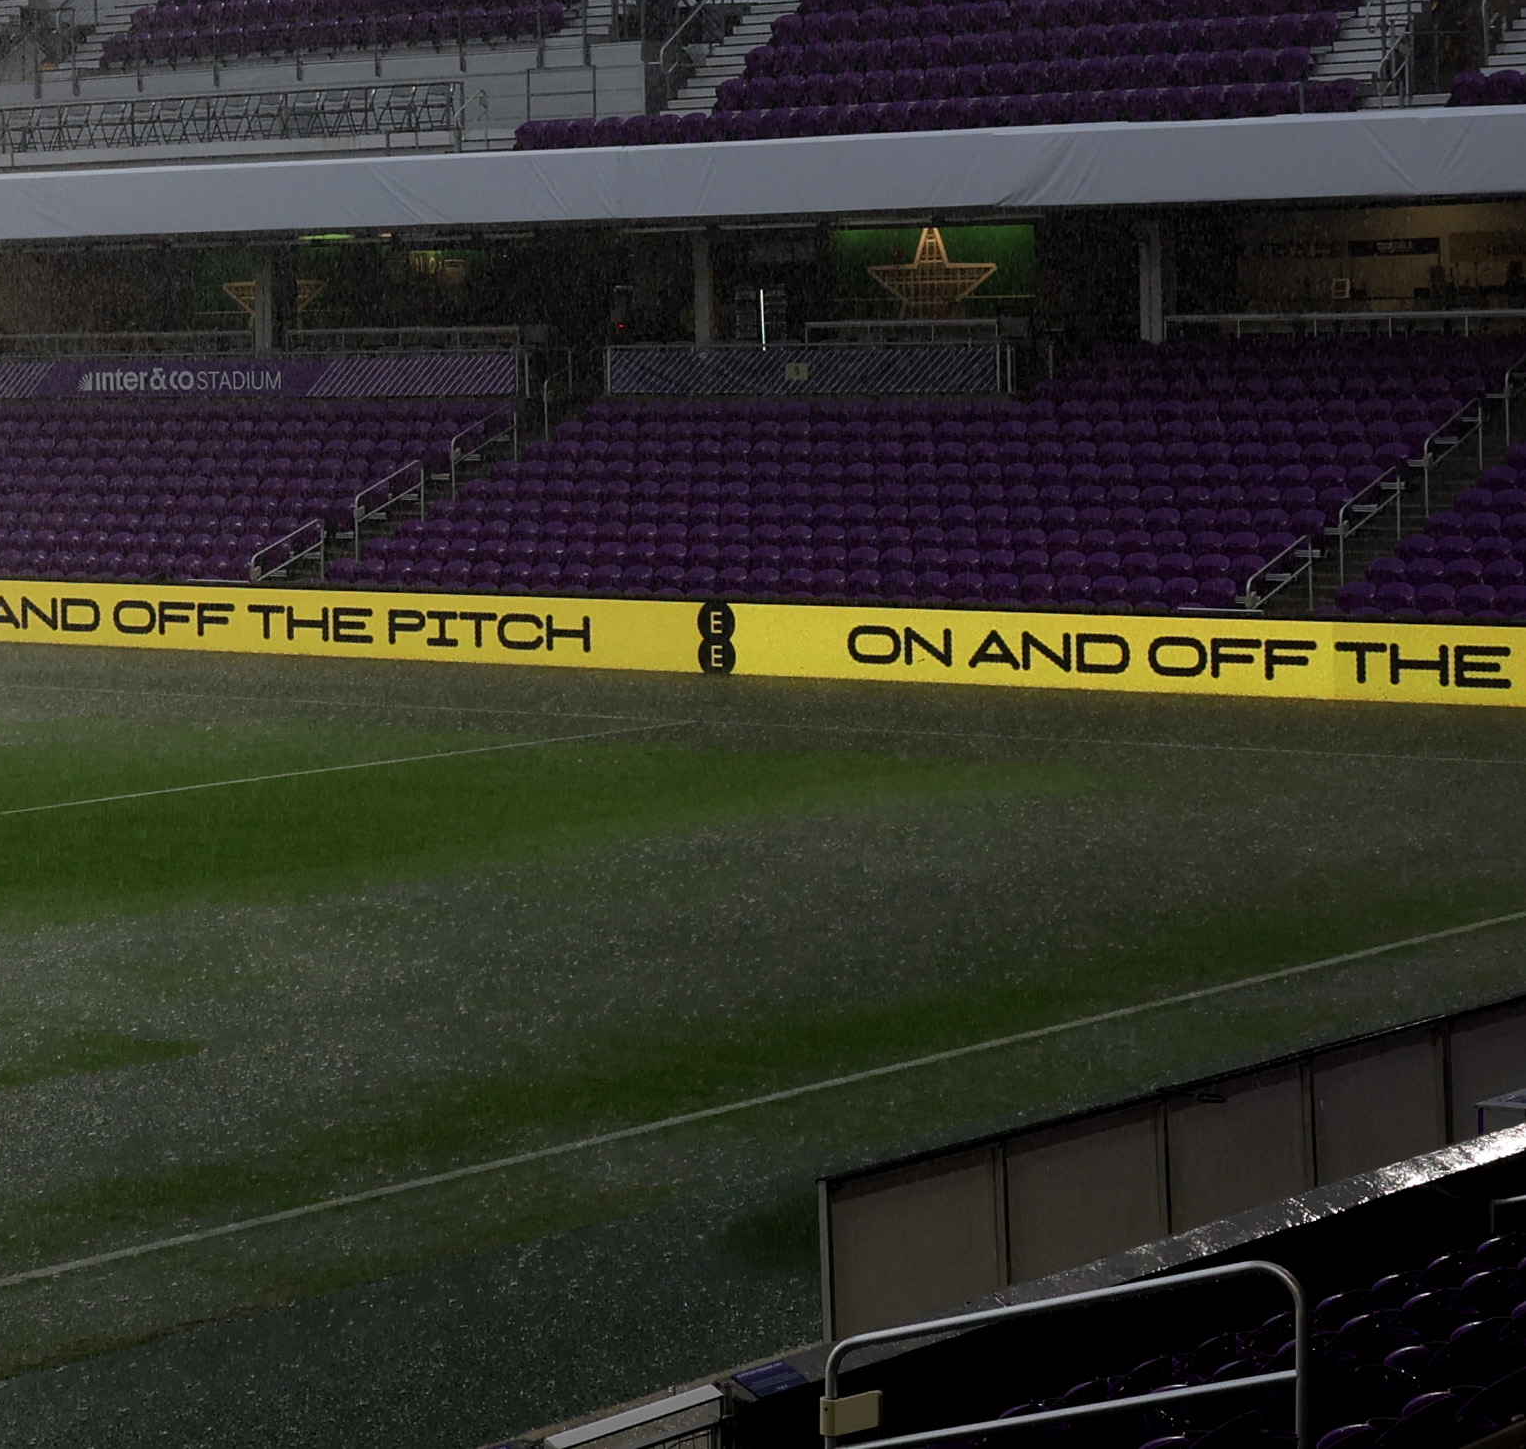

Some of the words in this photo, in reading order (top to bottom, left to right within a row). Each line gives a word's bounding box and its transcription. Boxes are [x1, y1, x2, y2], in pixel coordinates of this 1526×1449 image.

[95, 367, 195, 392] inter&co
[197, 370, 282, 391] STADIUM
[113, 600, 236, 638] OFF
[247, 605, 374, 644] THE
[388, 609, 592, 654] PITCH
[848, 625, 953, 668] ON
[968, 630, 1131, 675] AND
[1148, 636, 1318, 681] OFF
[1334, 641, 1513, 690] THE
